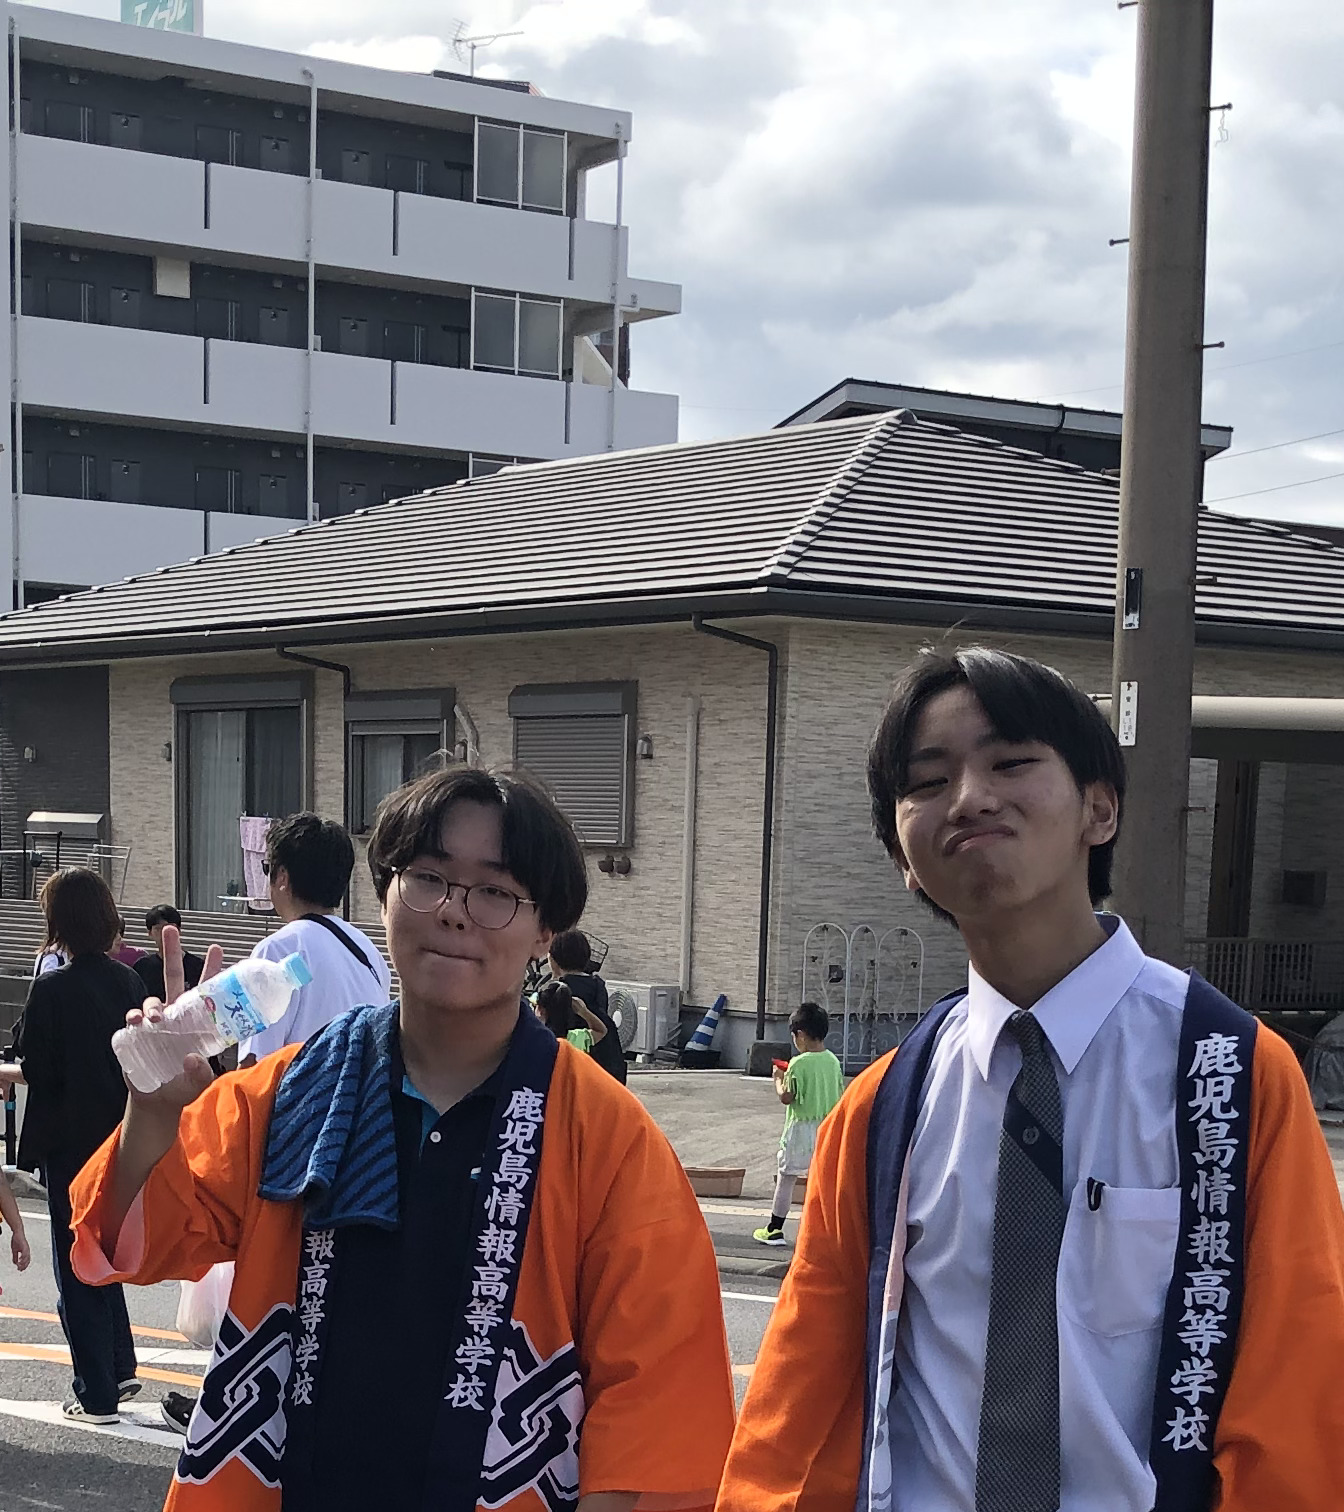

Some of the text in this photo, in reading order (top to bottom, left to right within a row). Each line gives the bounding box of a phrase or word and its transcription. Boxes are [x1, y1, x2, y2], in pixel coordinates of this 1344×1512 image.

[291, 1228, 335, 1406] 報高等学校
[444, 1086, 545, 1411] 鹿児島情報高等学校
[1161, 1033, 1244, 1452] 鹿児島情報高等学校
